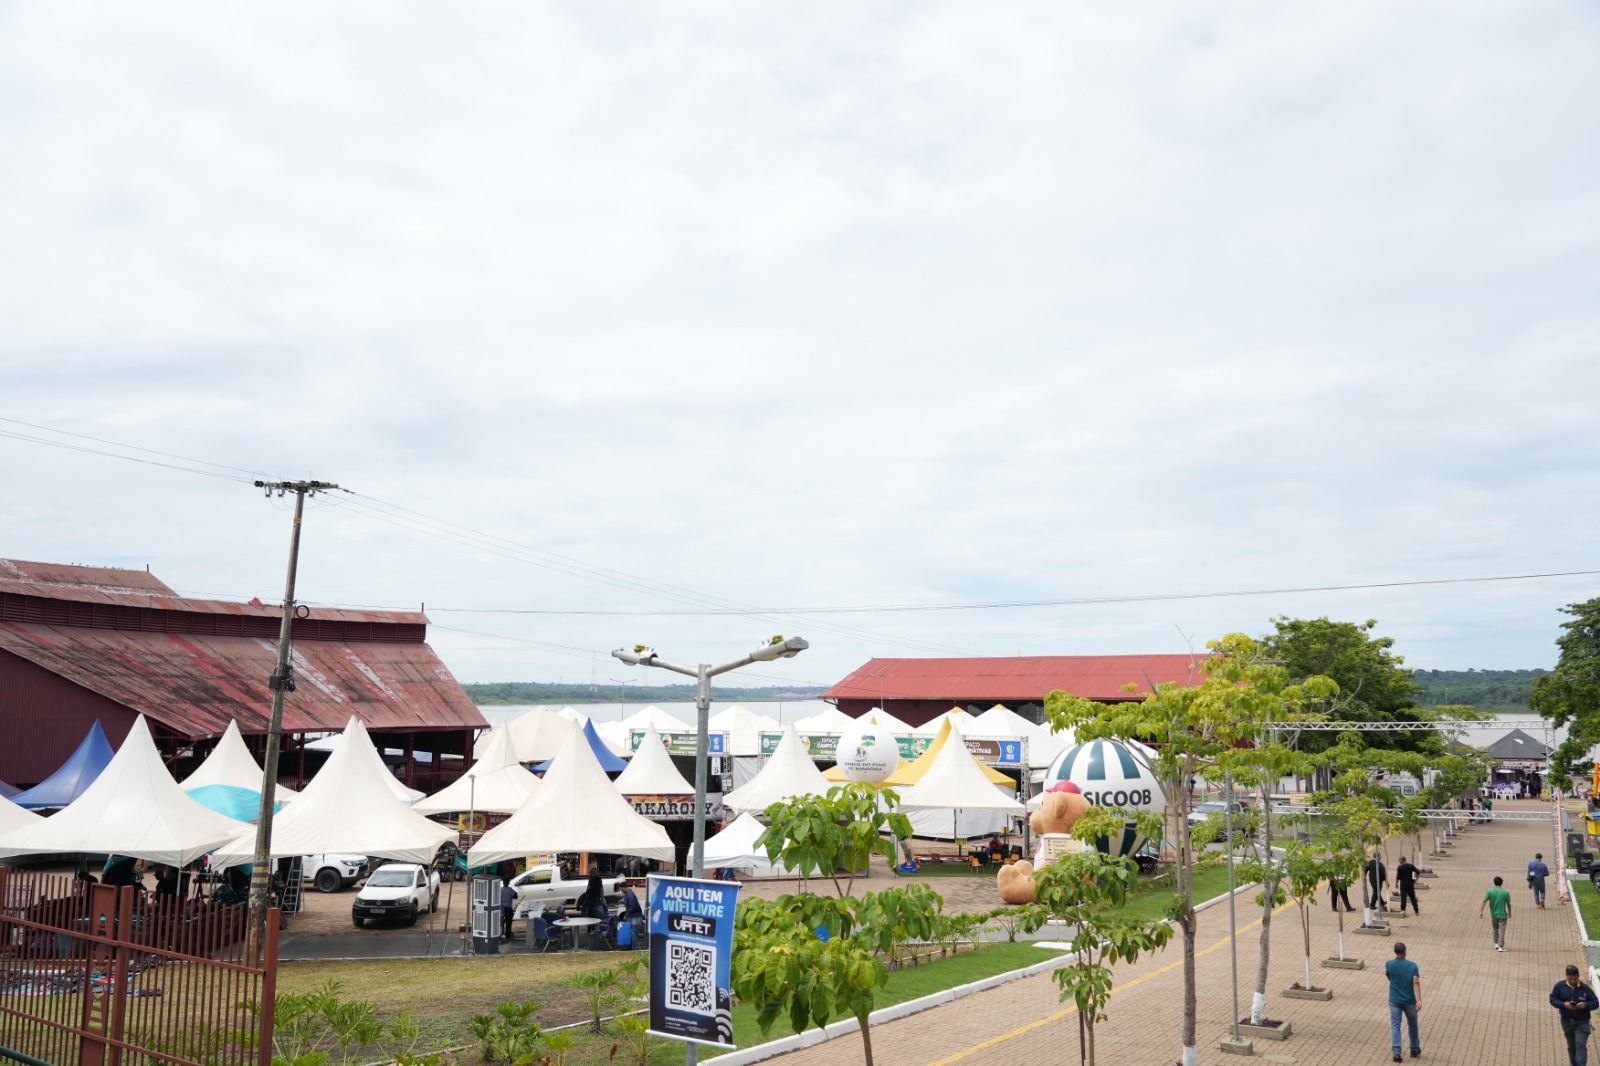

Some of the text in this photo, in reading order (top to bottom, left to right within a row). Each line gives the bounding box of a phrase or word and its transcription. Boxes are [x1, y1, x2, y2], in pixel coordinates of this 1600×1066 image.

[1083, 789, 1152, 807] SICOOB
[665, 886, 723, 903] AQUI TEM
[691, 902, 724, 917] LIVRE
